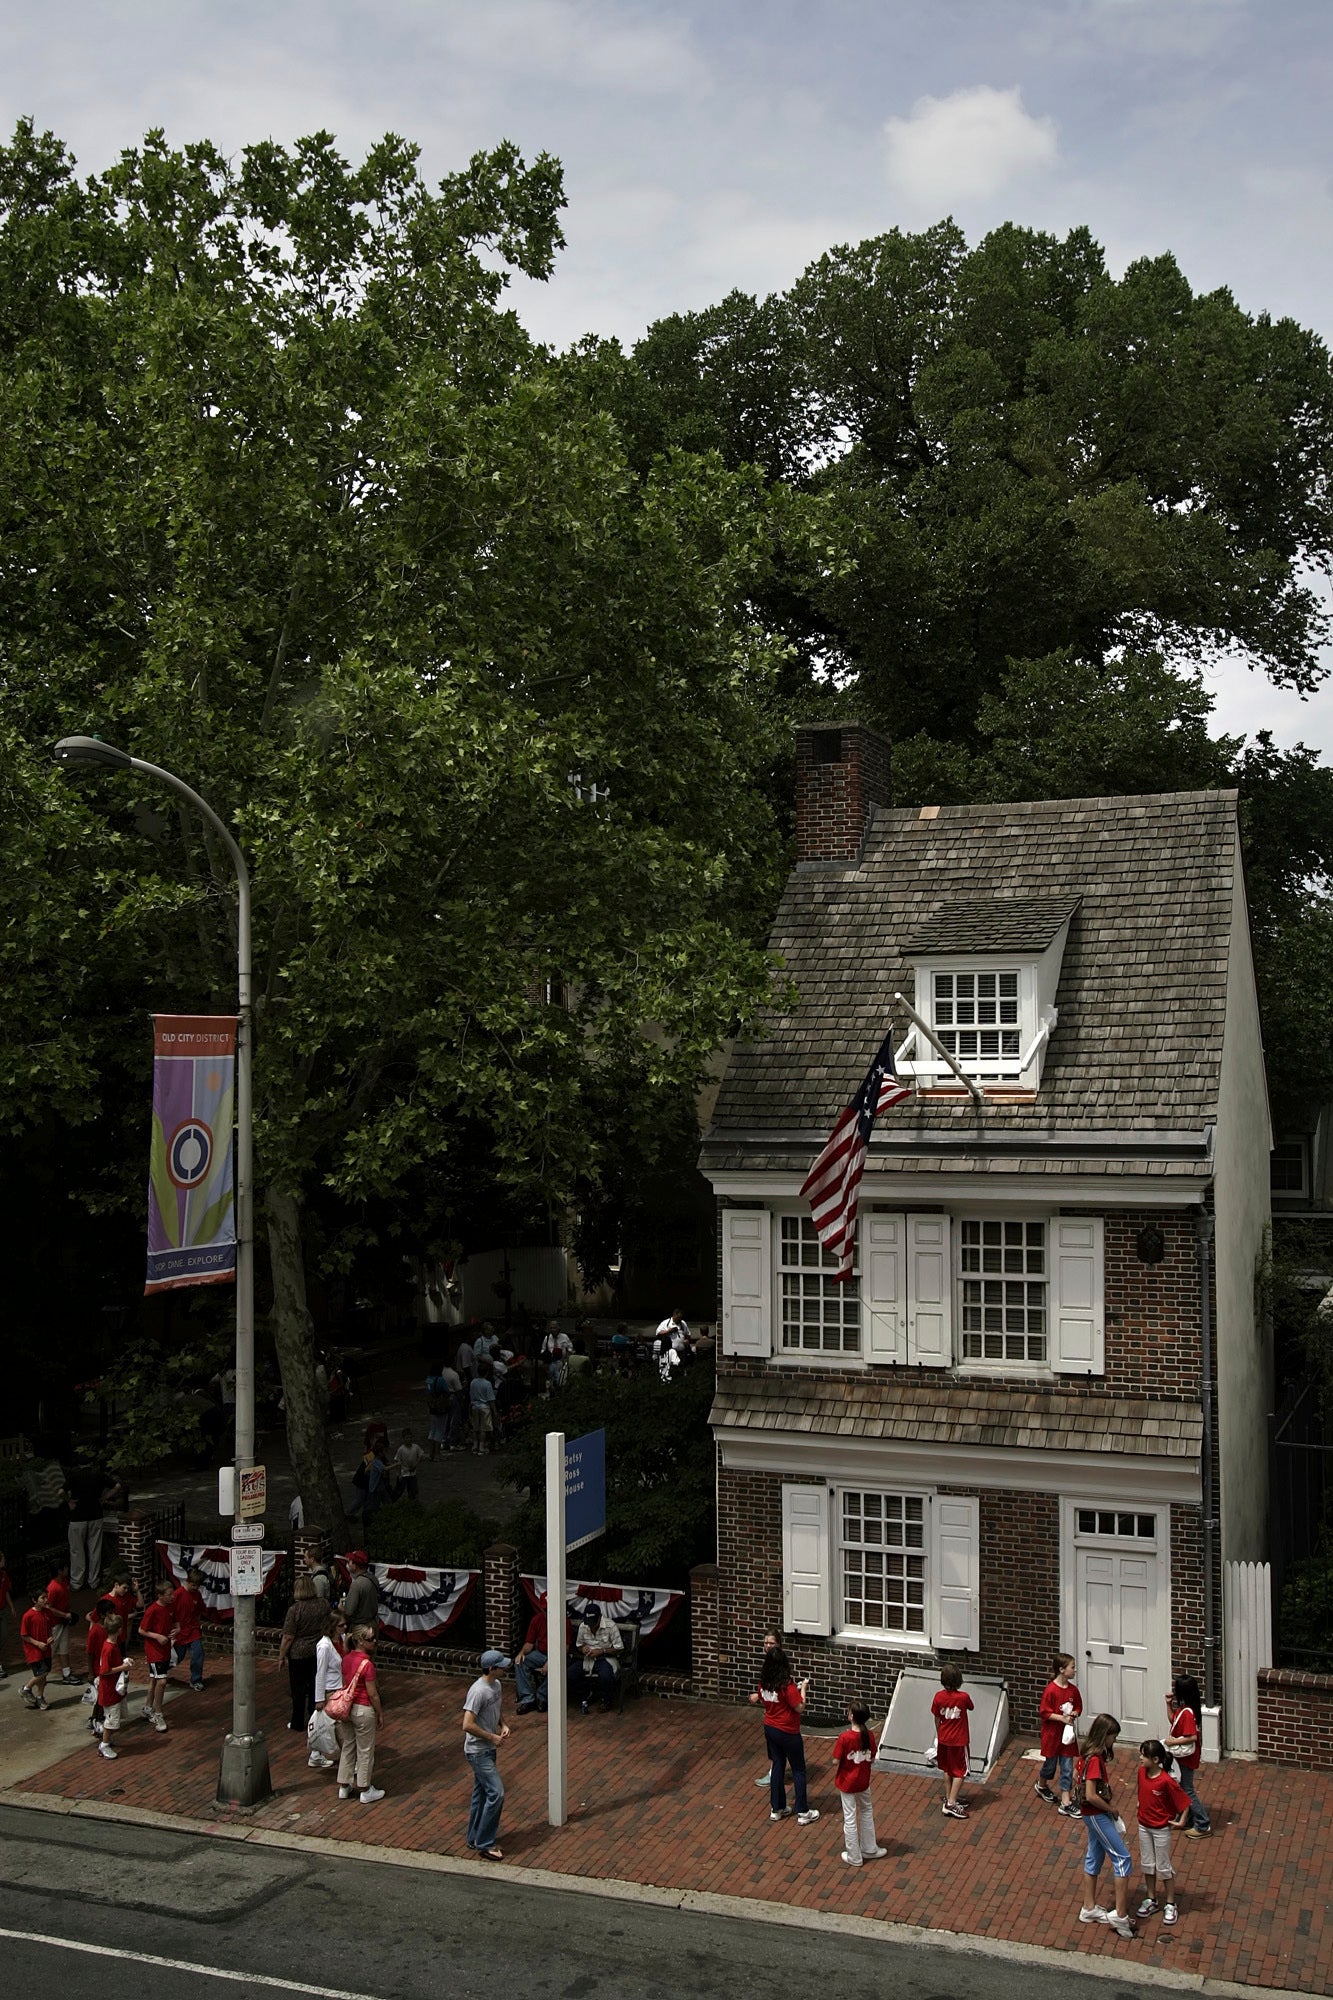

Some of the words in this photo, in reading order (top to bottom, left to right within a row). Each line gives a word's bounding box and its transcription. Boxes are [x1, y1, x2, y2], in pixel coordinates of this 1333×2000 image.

[162, 1033, 176, 1042] OLD
[177, 1033, 195, 1042] CITY
[196, 1033, 230, 1043] DISTRICT
[565, 1451, 583, 1466] Betsy
[565, 1468, 580, 1481] Ross
